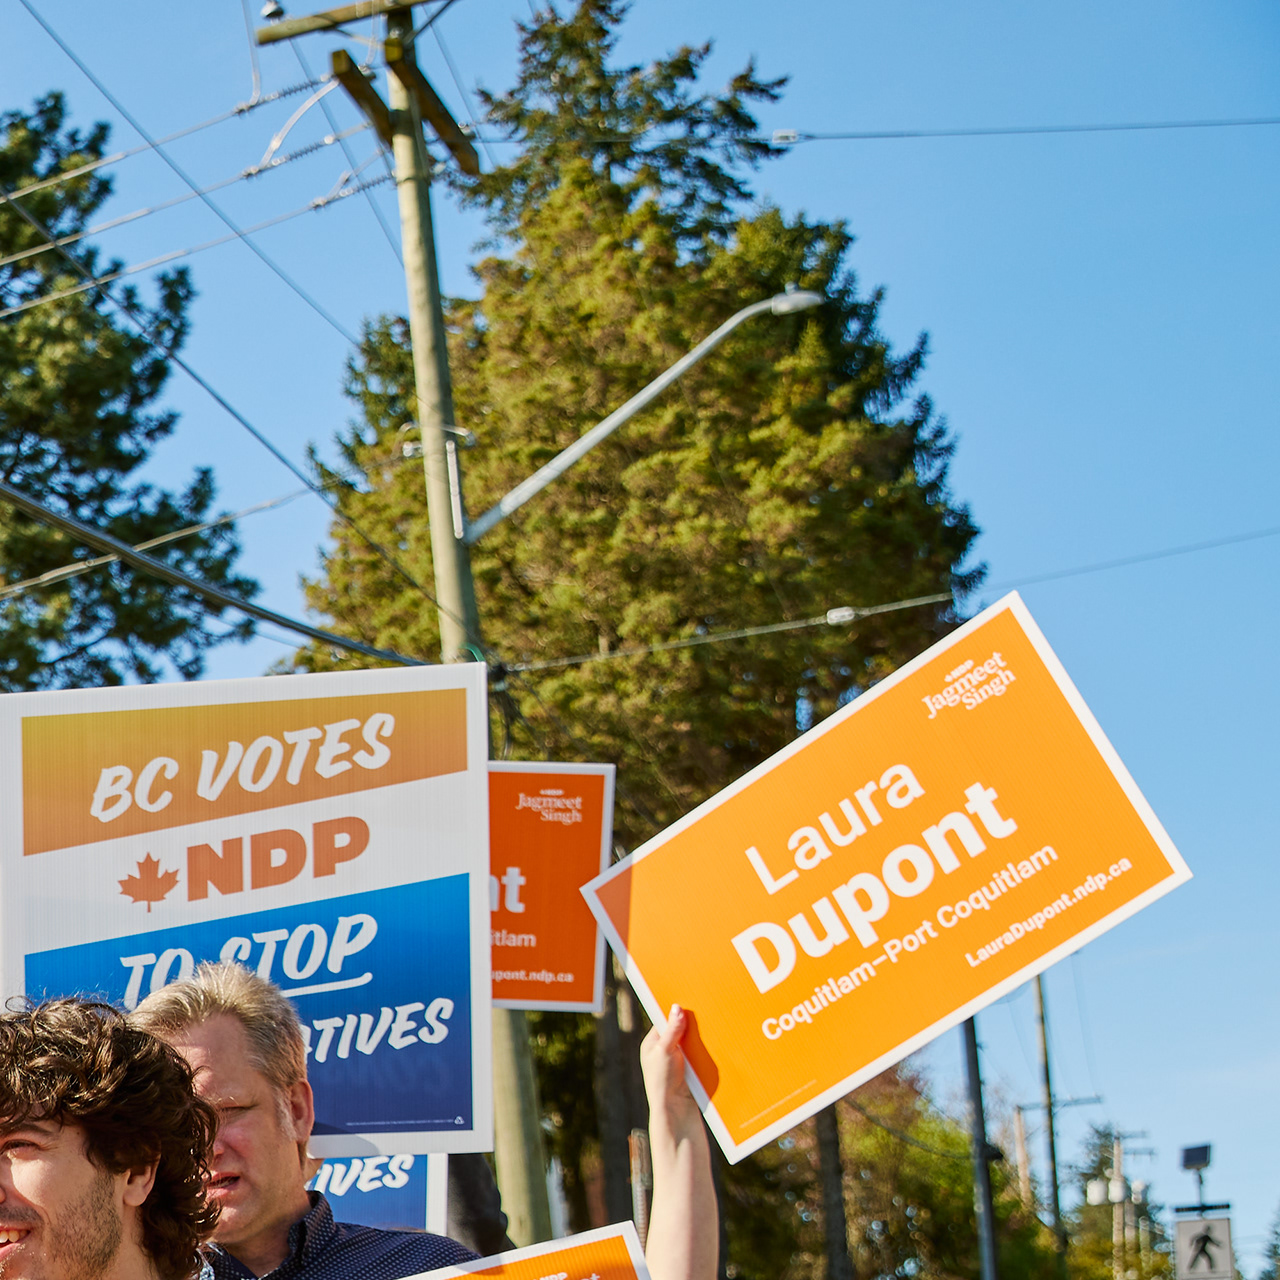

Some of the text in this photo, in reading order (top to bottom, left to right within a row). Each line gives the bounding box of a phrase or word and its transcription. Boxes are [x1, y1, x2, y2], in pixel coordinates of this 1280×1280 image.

[922, 651, 1007, 719] Jagmeet
[961, 666, 1017, 711] Singh
[90, 713, 396, 823] BC VOTES
[515, 793, 583, 812] Jagmeet
[540, 808, 583, 825] Singh
[745, 764, 926, 896] Laura
[186, 816, 370, 903] NDP
[731, 781, 1018, 994] Dupont
[936, 844, 1059, 929] Coquitlam
[965, 856, 1133, 968] LauraDupont.ndp.ca
[120, 948, 194, 1011] TO
